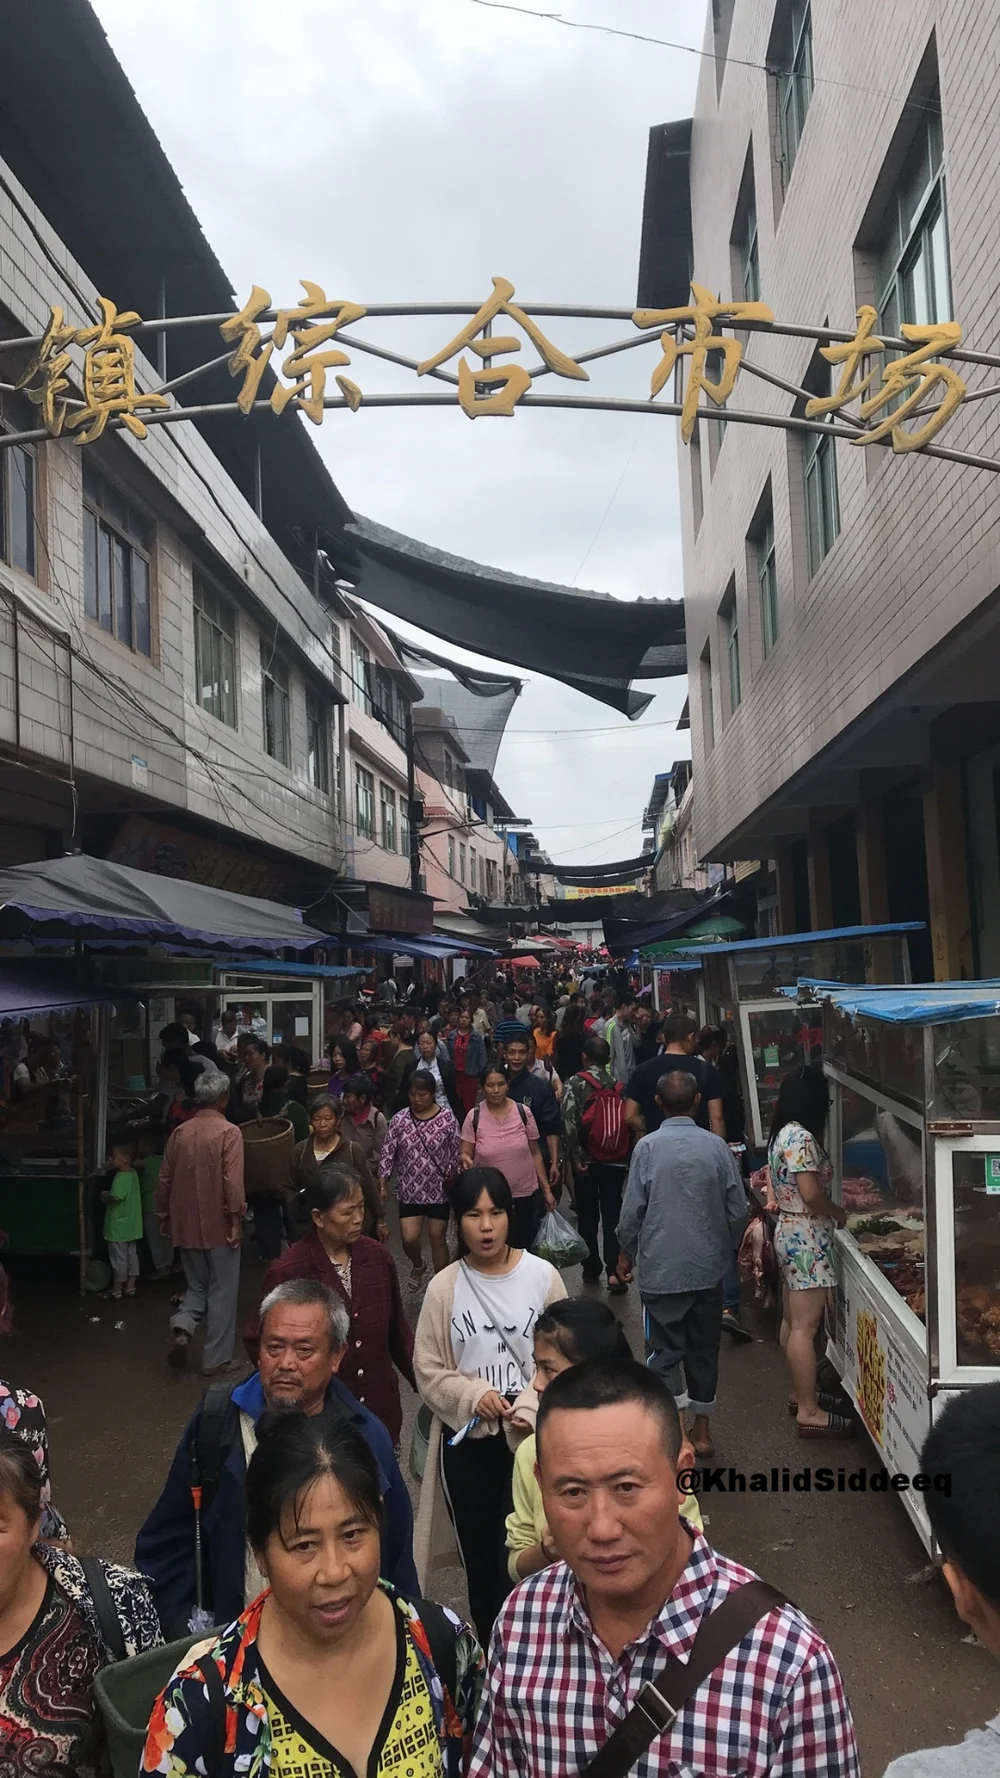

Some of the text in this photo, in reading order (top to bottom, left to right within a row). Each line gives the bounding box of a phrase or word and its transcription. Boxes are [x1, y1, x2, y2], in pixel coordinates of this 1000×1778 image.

[16, 278, 967, 453] 镇综合市场
